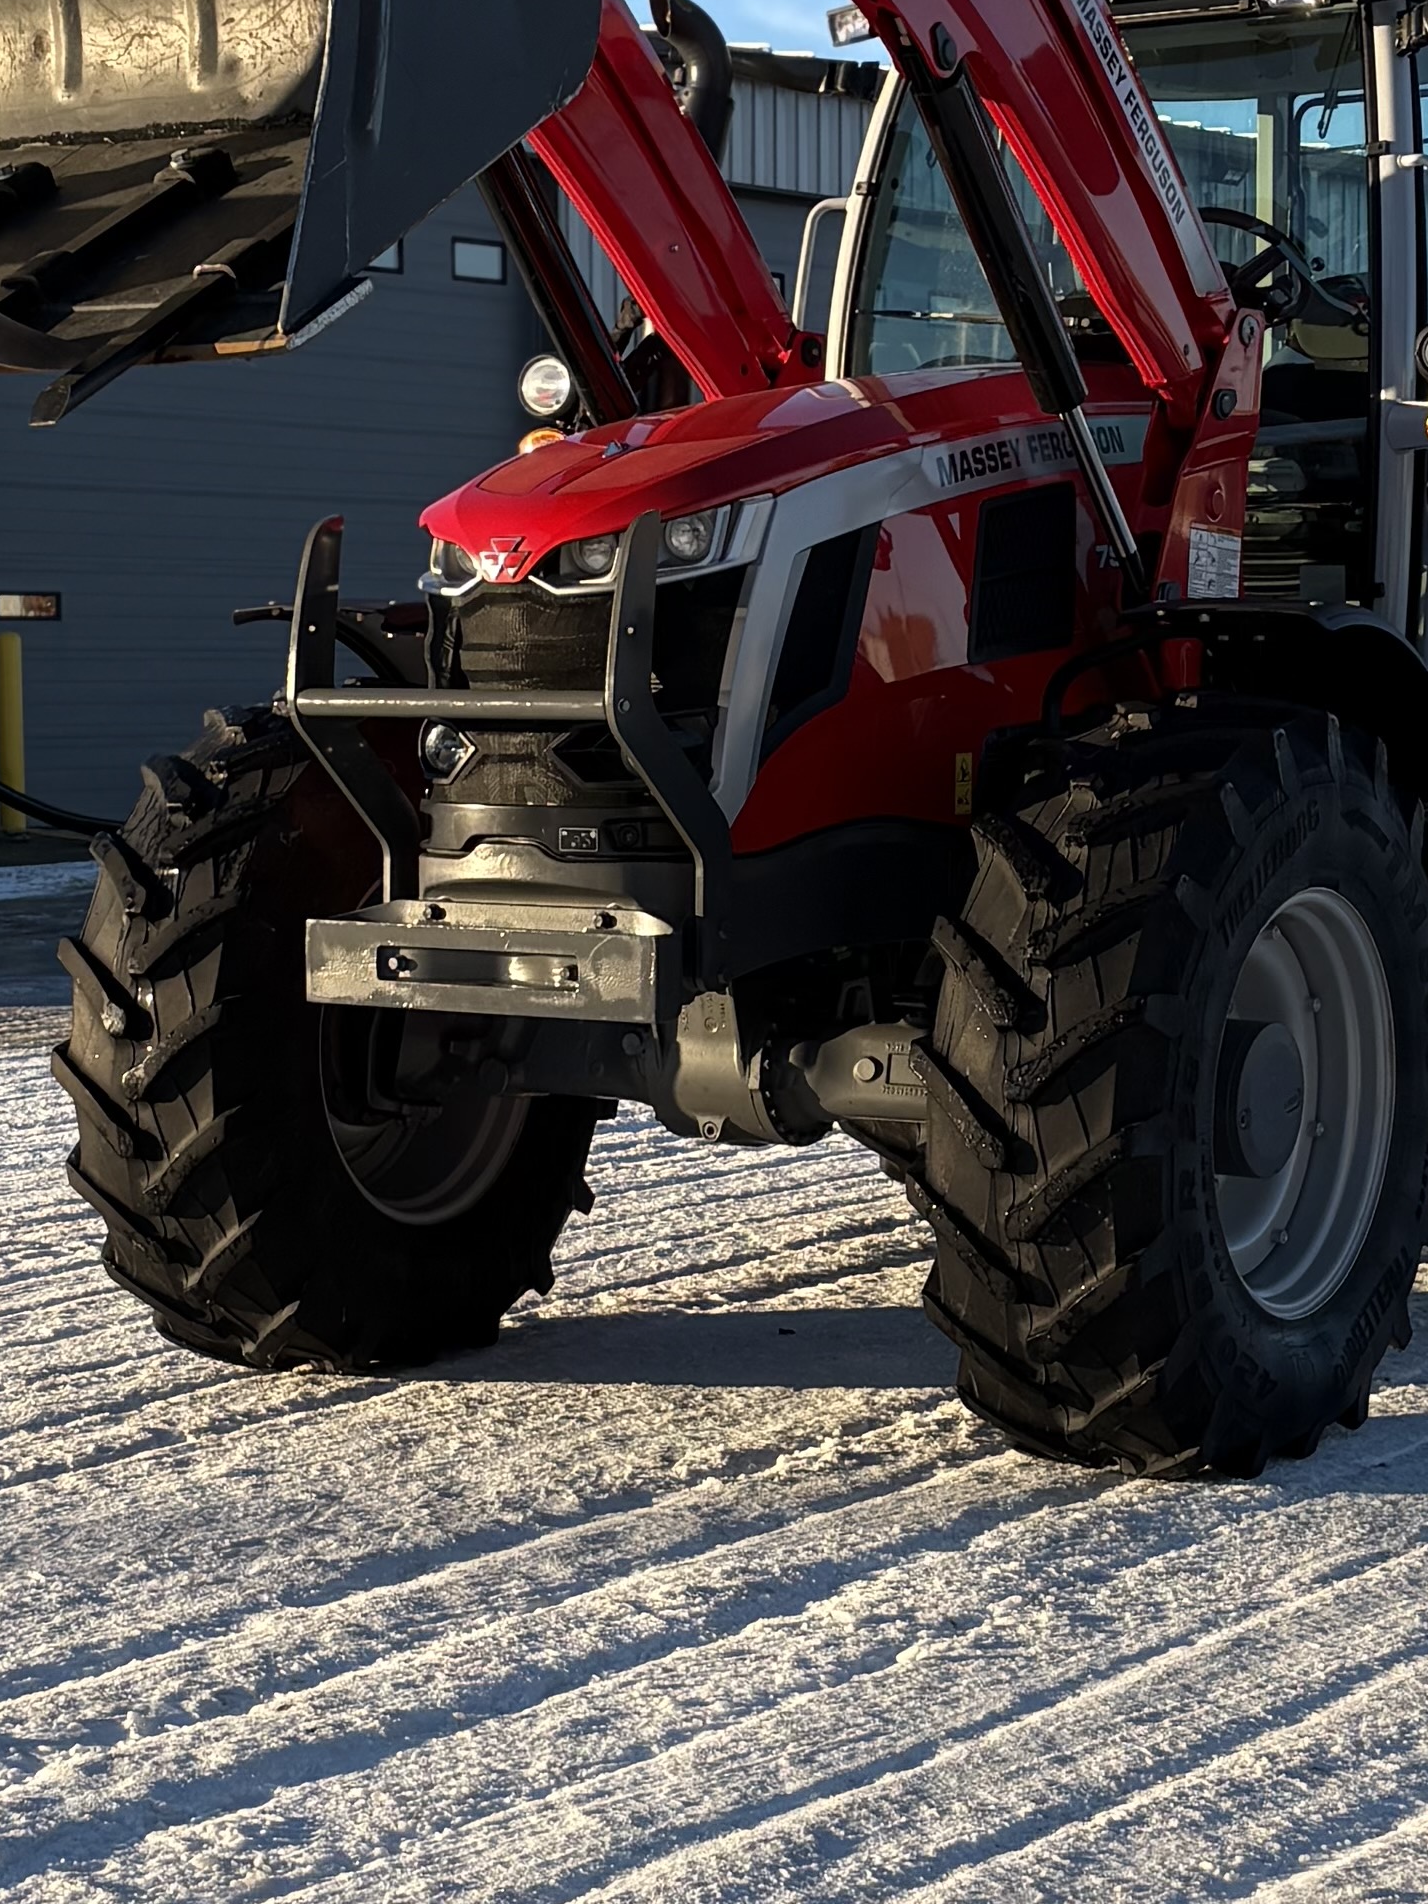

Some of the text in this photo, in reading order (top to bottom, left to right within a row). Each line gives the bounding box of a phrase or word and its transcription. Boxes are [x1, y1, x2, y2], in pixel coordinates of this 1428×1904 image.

[1124, 88, 1186, 225] FERGUSON
[936, 426, 1125, 487] MASSEY FERGON
